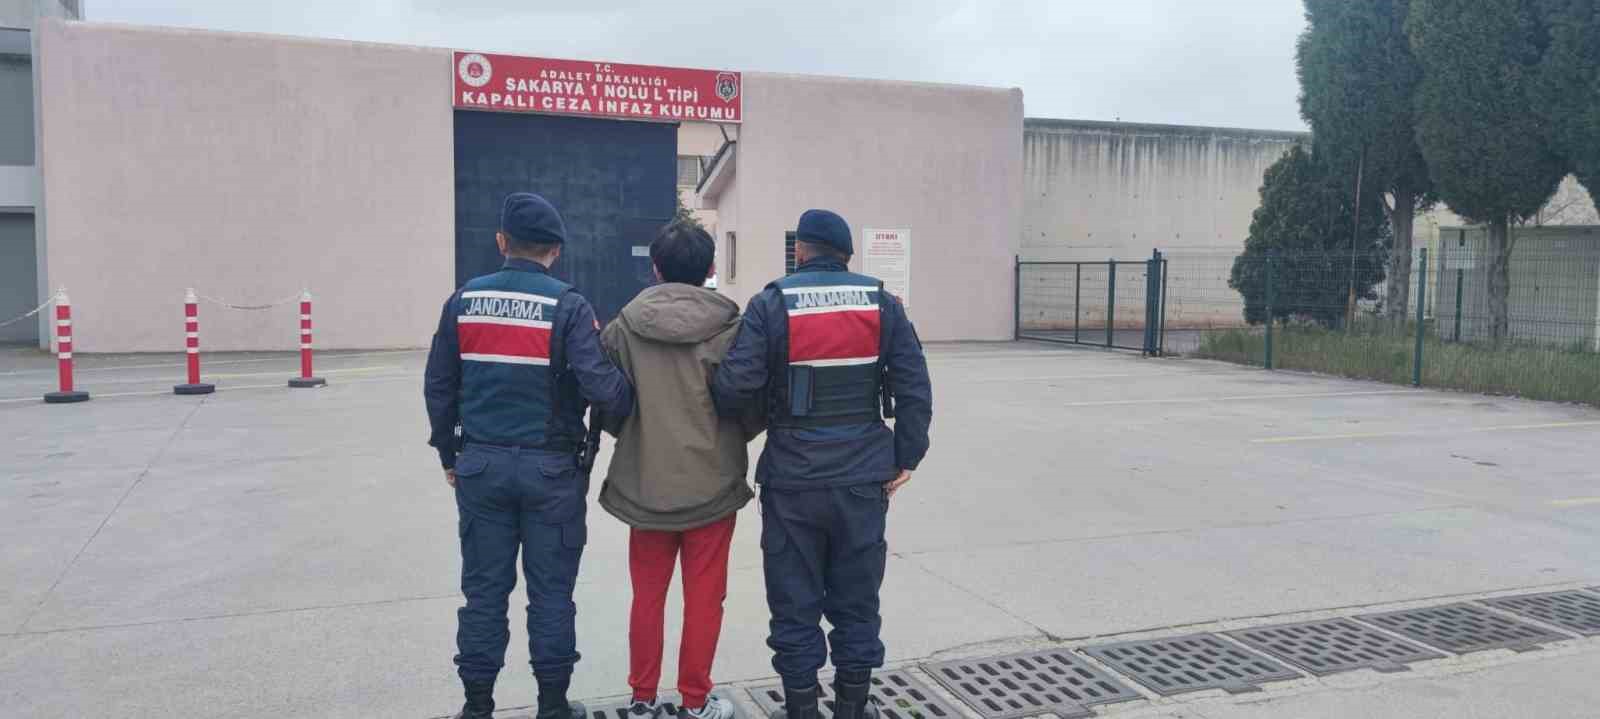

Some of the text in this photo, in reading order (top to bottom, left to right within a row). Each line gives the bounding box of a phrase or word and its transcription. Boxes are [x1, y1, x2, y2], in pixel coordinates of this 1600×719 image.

[540, 69, 667, 86] ADALET BAKANLIĞI
[594, 63, 615, 73] T.C.
[505, 77, 699, 104] SAKARYA 1 NOLU L TİPİ
[462, 91, 736, 119] KAPALI CEZA İNFAZ KURUMU
[465, 297, 544, 320] JANDARMA
[795, 289, 871, 308] JANDARMA
